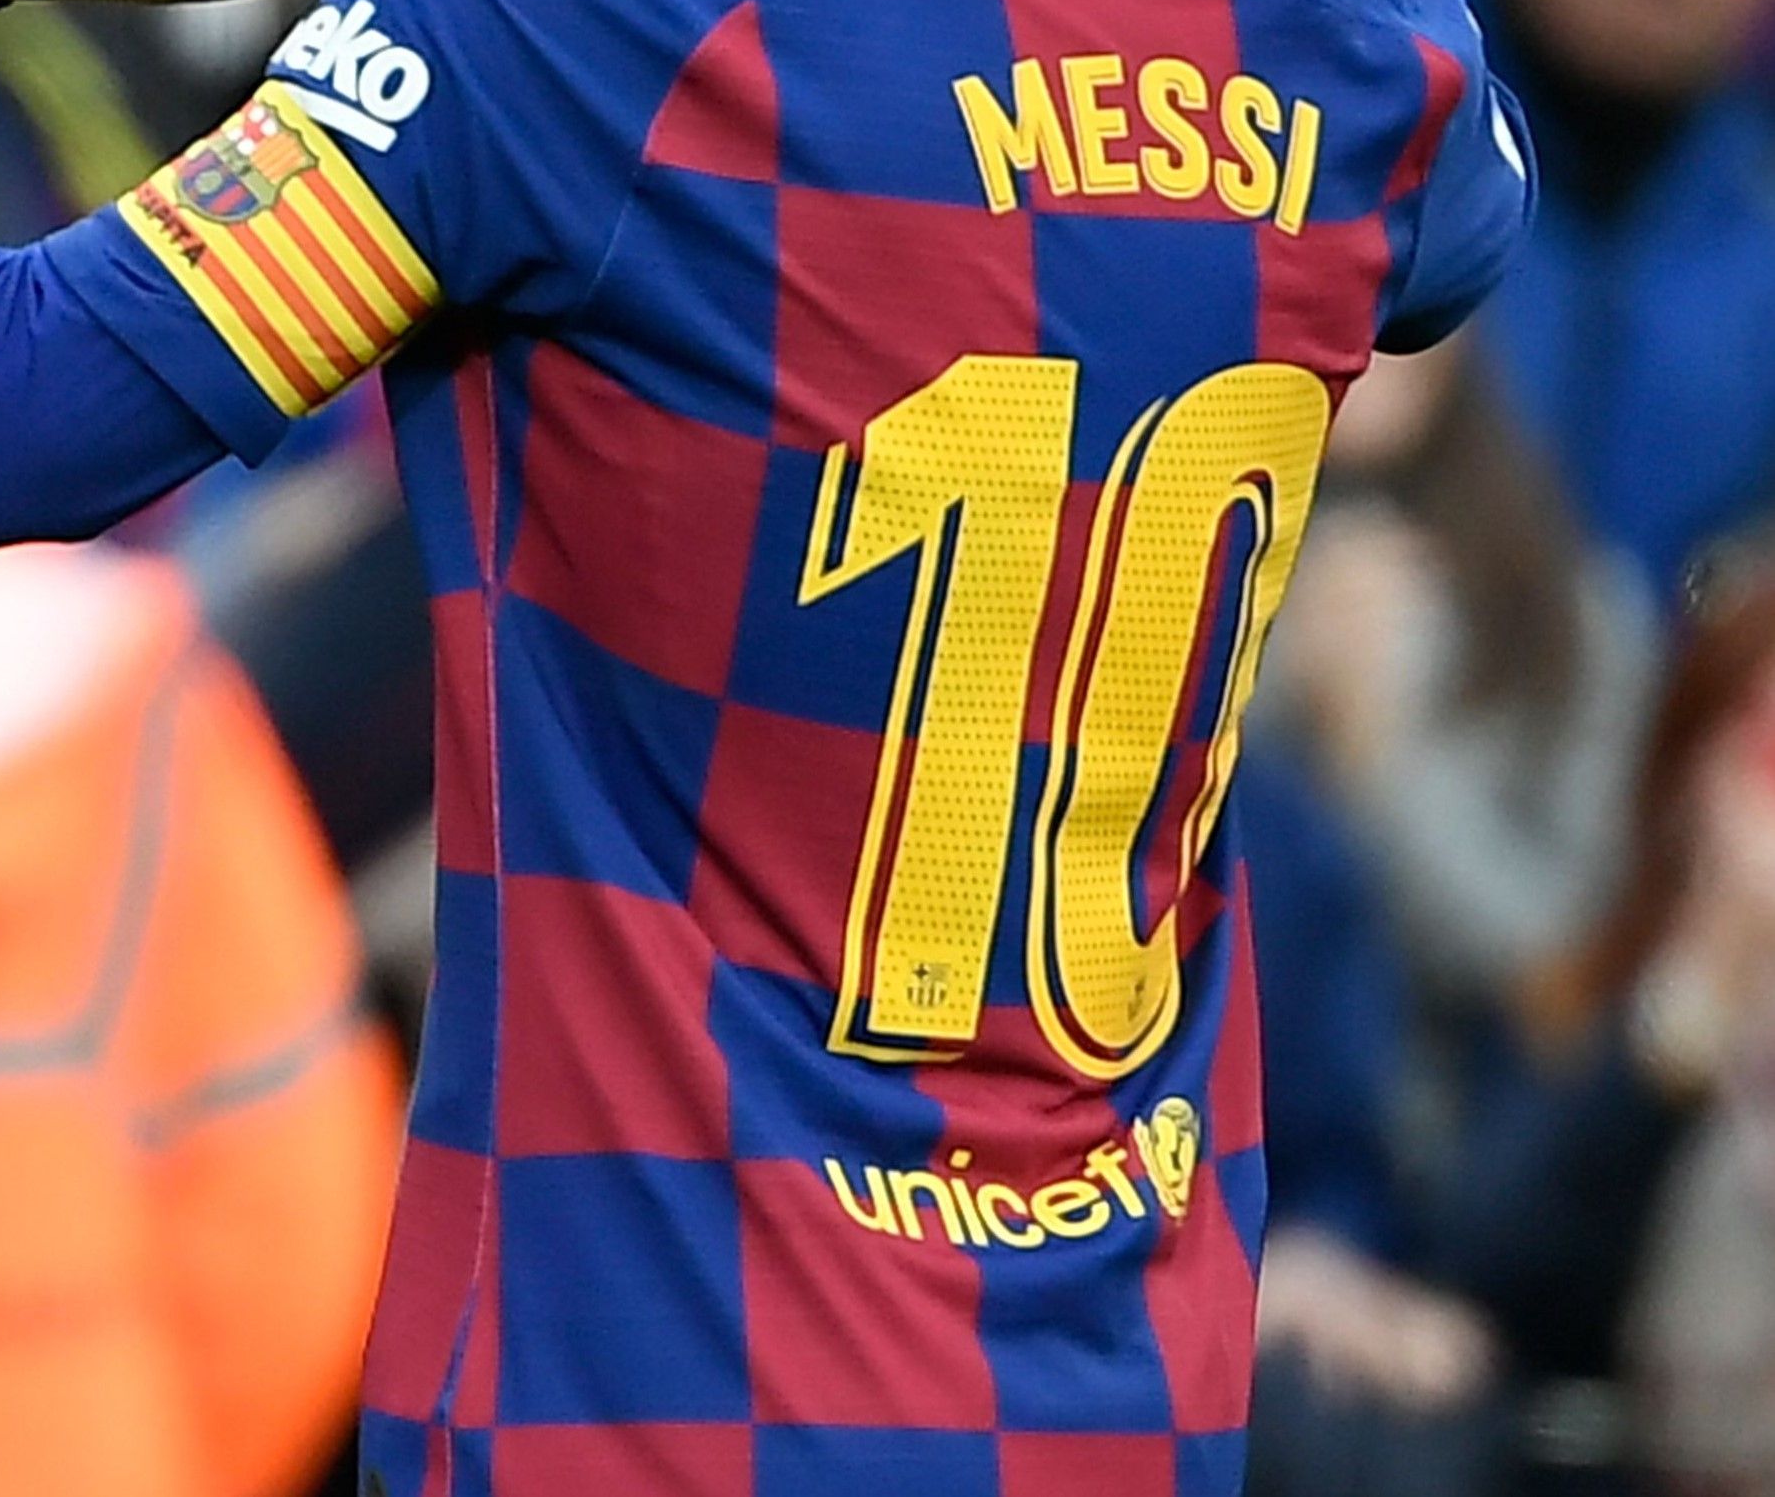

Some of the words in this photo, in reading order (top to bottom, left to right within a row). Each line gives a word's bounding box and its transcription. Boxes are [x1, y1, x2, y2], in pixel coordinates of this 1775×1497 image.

[953, 54, 1321, 237] MESSI
[798, 354, 1332, 1080] 10
[824, 1139, 1147, 1249] unicef
